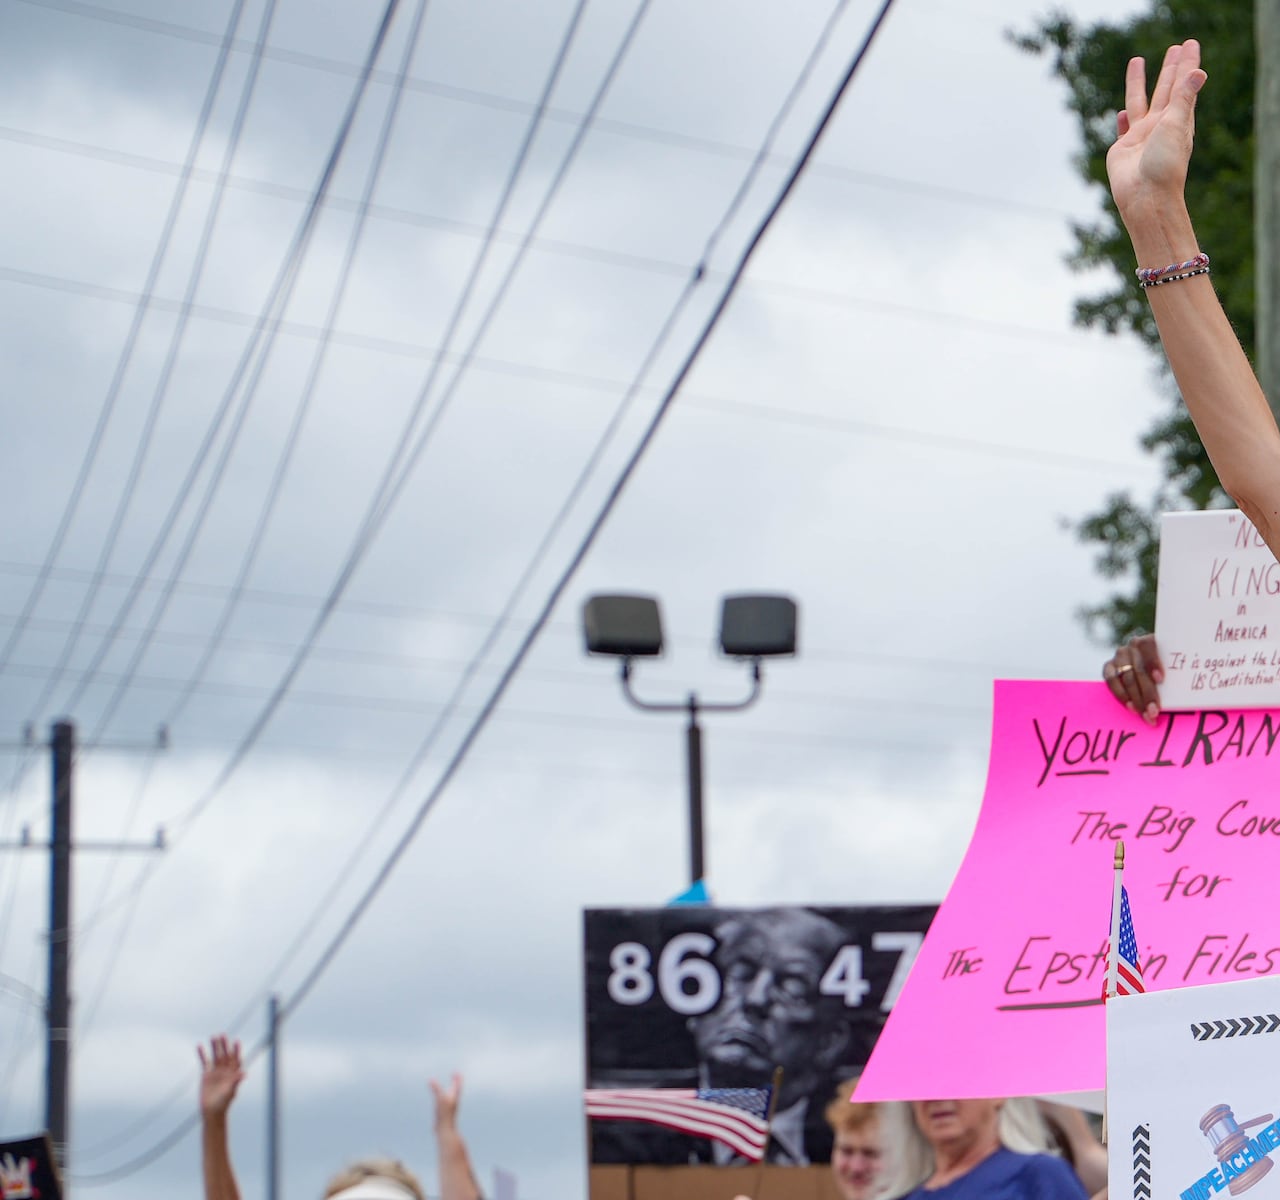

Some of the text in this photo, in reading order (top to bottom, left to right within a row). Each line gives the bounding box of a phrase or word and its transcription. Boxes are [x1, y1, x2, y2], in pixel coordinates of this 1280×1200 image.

[1208, 558, 1280, 599] KING
[1071, 811, 1128, 844] The
[1136, 806, 1196, 853] Big
[1157, 865, 1232, 902] for
[607, 932, 926, 1014] 86 47
[943, 946, 983, 980] The
[1184, 933, 1280, 981] Files
